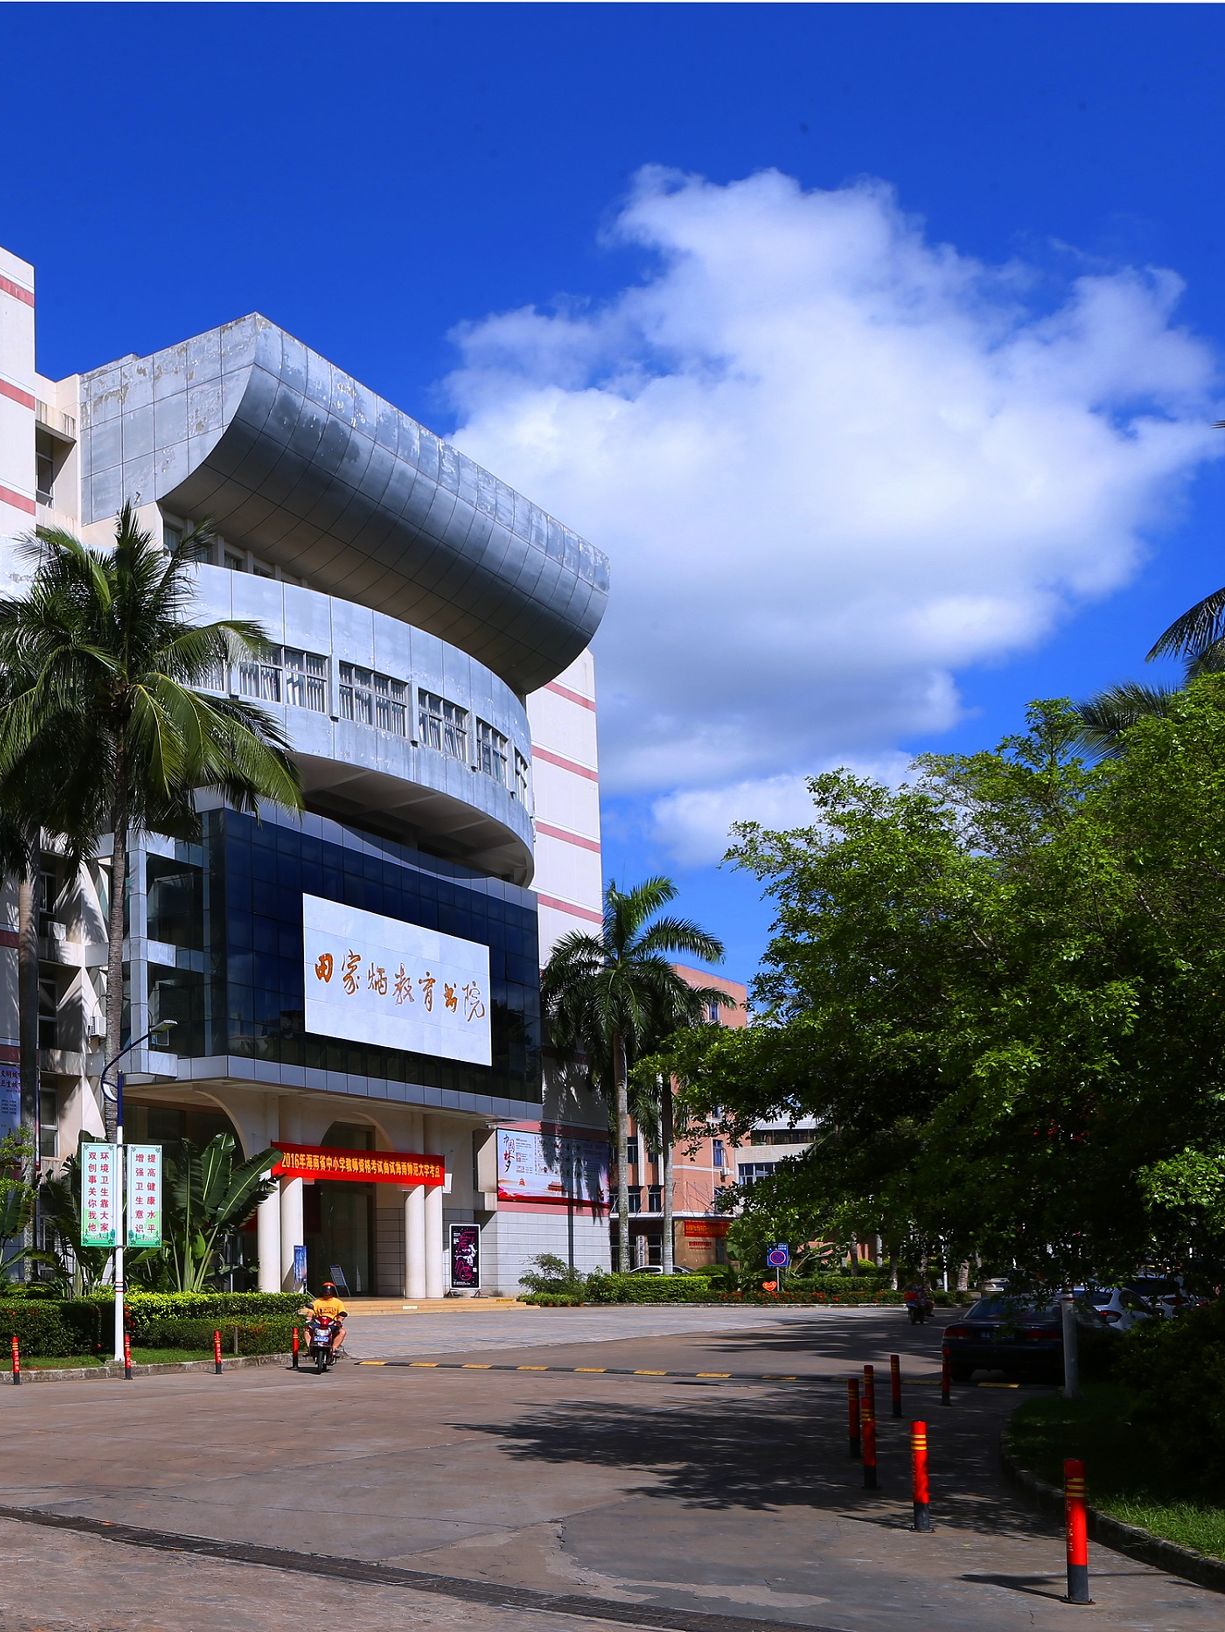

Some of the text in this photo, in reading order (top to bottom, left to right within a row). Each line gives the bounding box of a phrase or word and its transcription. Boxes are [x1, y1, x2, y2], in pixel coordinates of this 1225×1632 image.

[88, 1151, 97, 1232] 双创事关你我他
[100, 1151, 109, 1232] 环境卫生靠大家
[135, 1153, 144, 1233] 增强卫生意识
[147, 1154, 156, 1234] 提高健康水平
